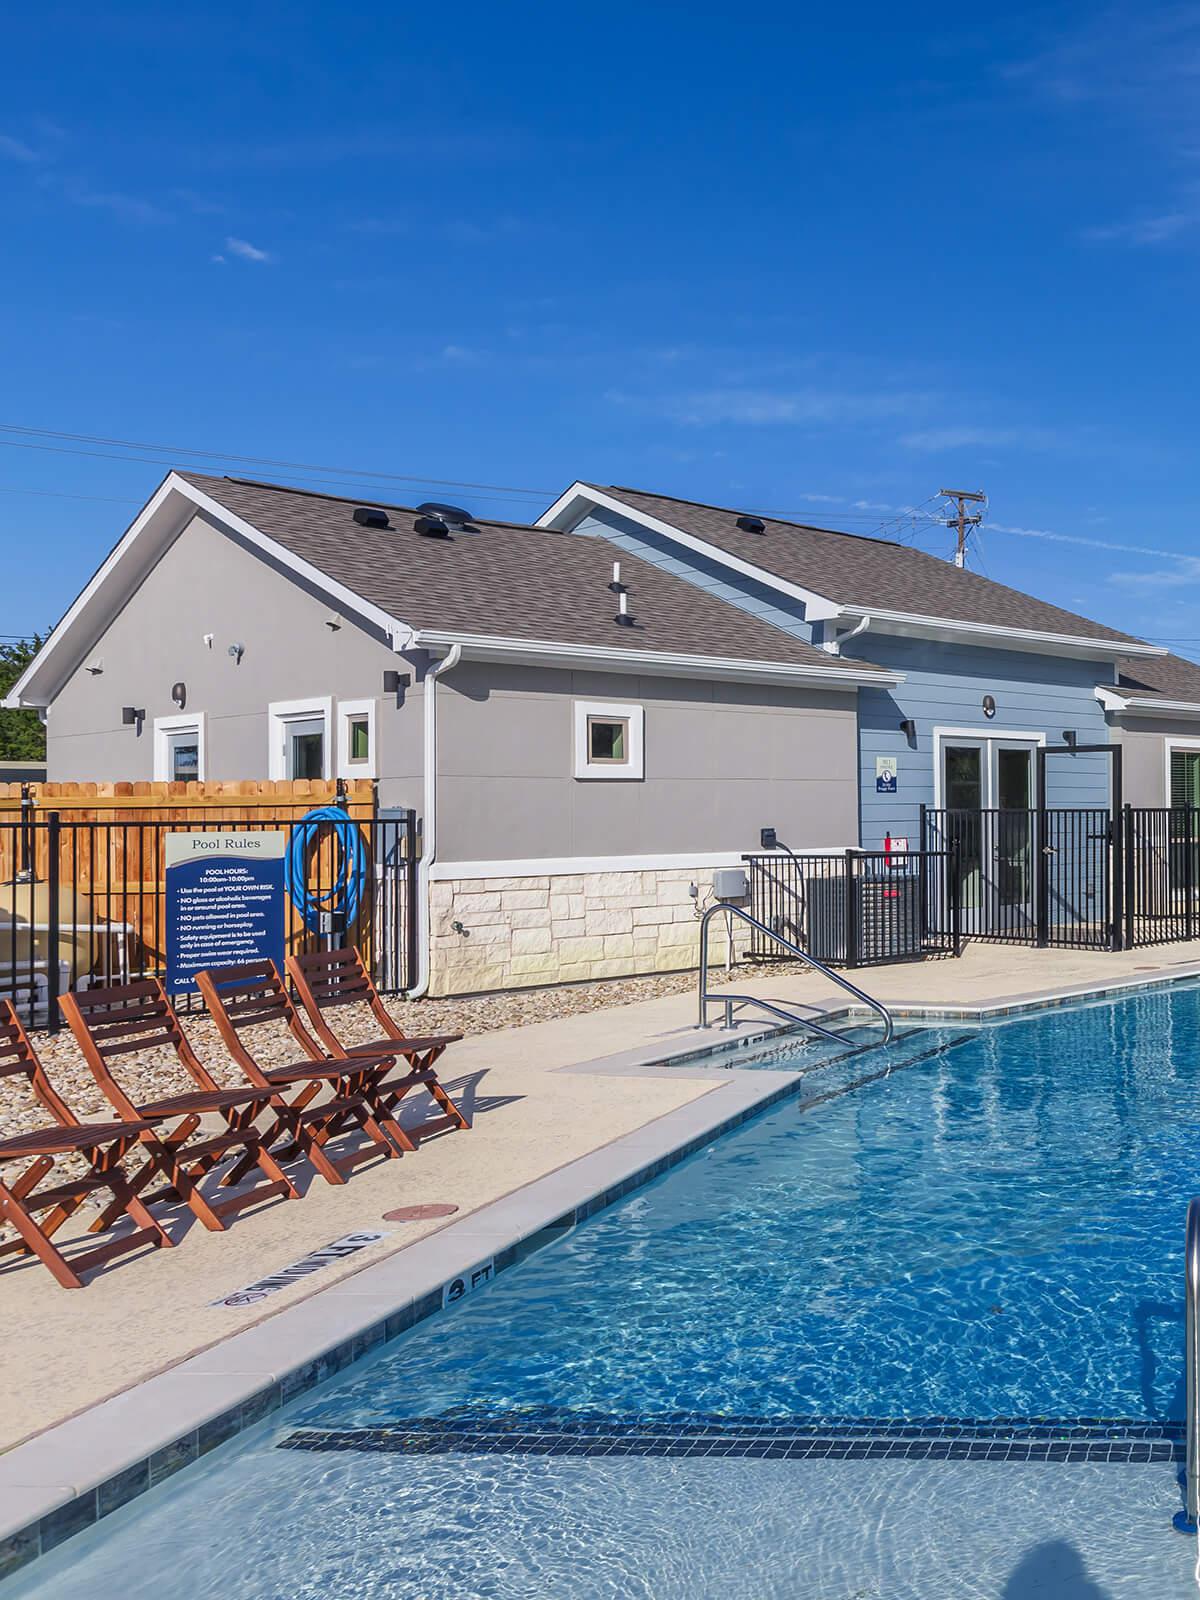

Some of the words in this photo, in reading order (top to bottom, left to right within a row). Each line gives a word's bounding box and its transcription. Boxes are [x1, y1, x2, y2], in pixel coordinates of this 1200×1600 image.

[192, 839, 220, 850] Pool
[225, 838, 261, 849] Rules
[203, 886, 217, 894] pool
[174, 977, 191, 985] CALL
[310, 1245, 367, 1258] FT
[448, 1278, 465, 1302] 3
[471, 1264, 492, 1288] FT
